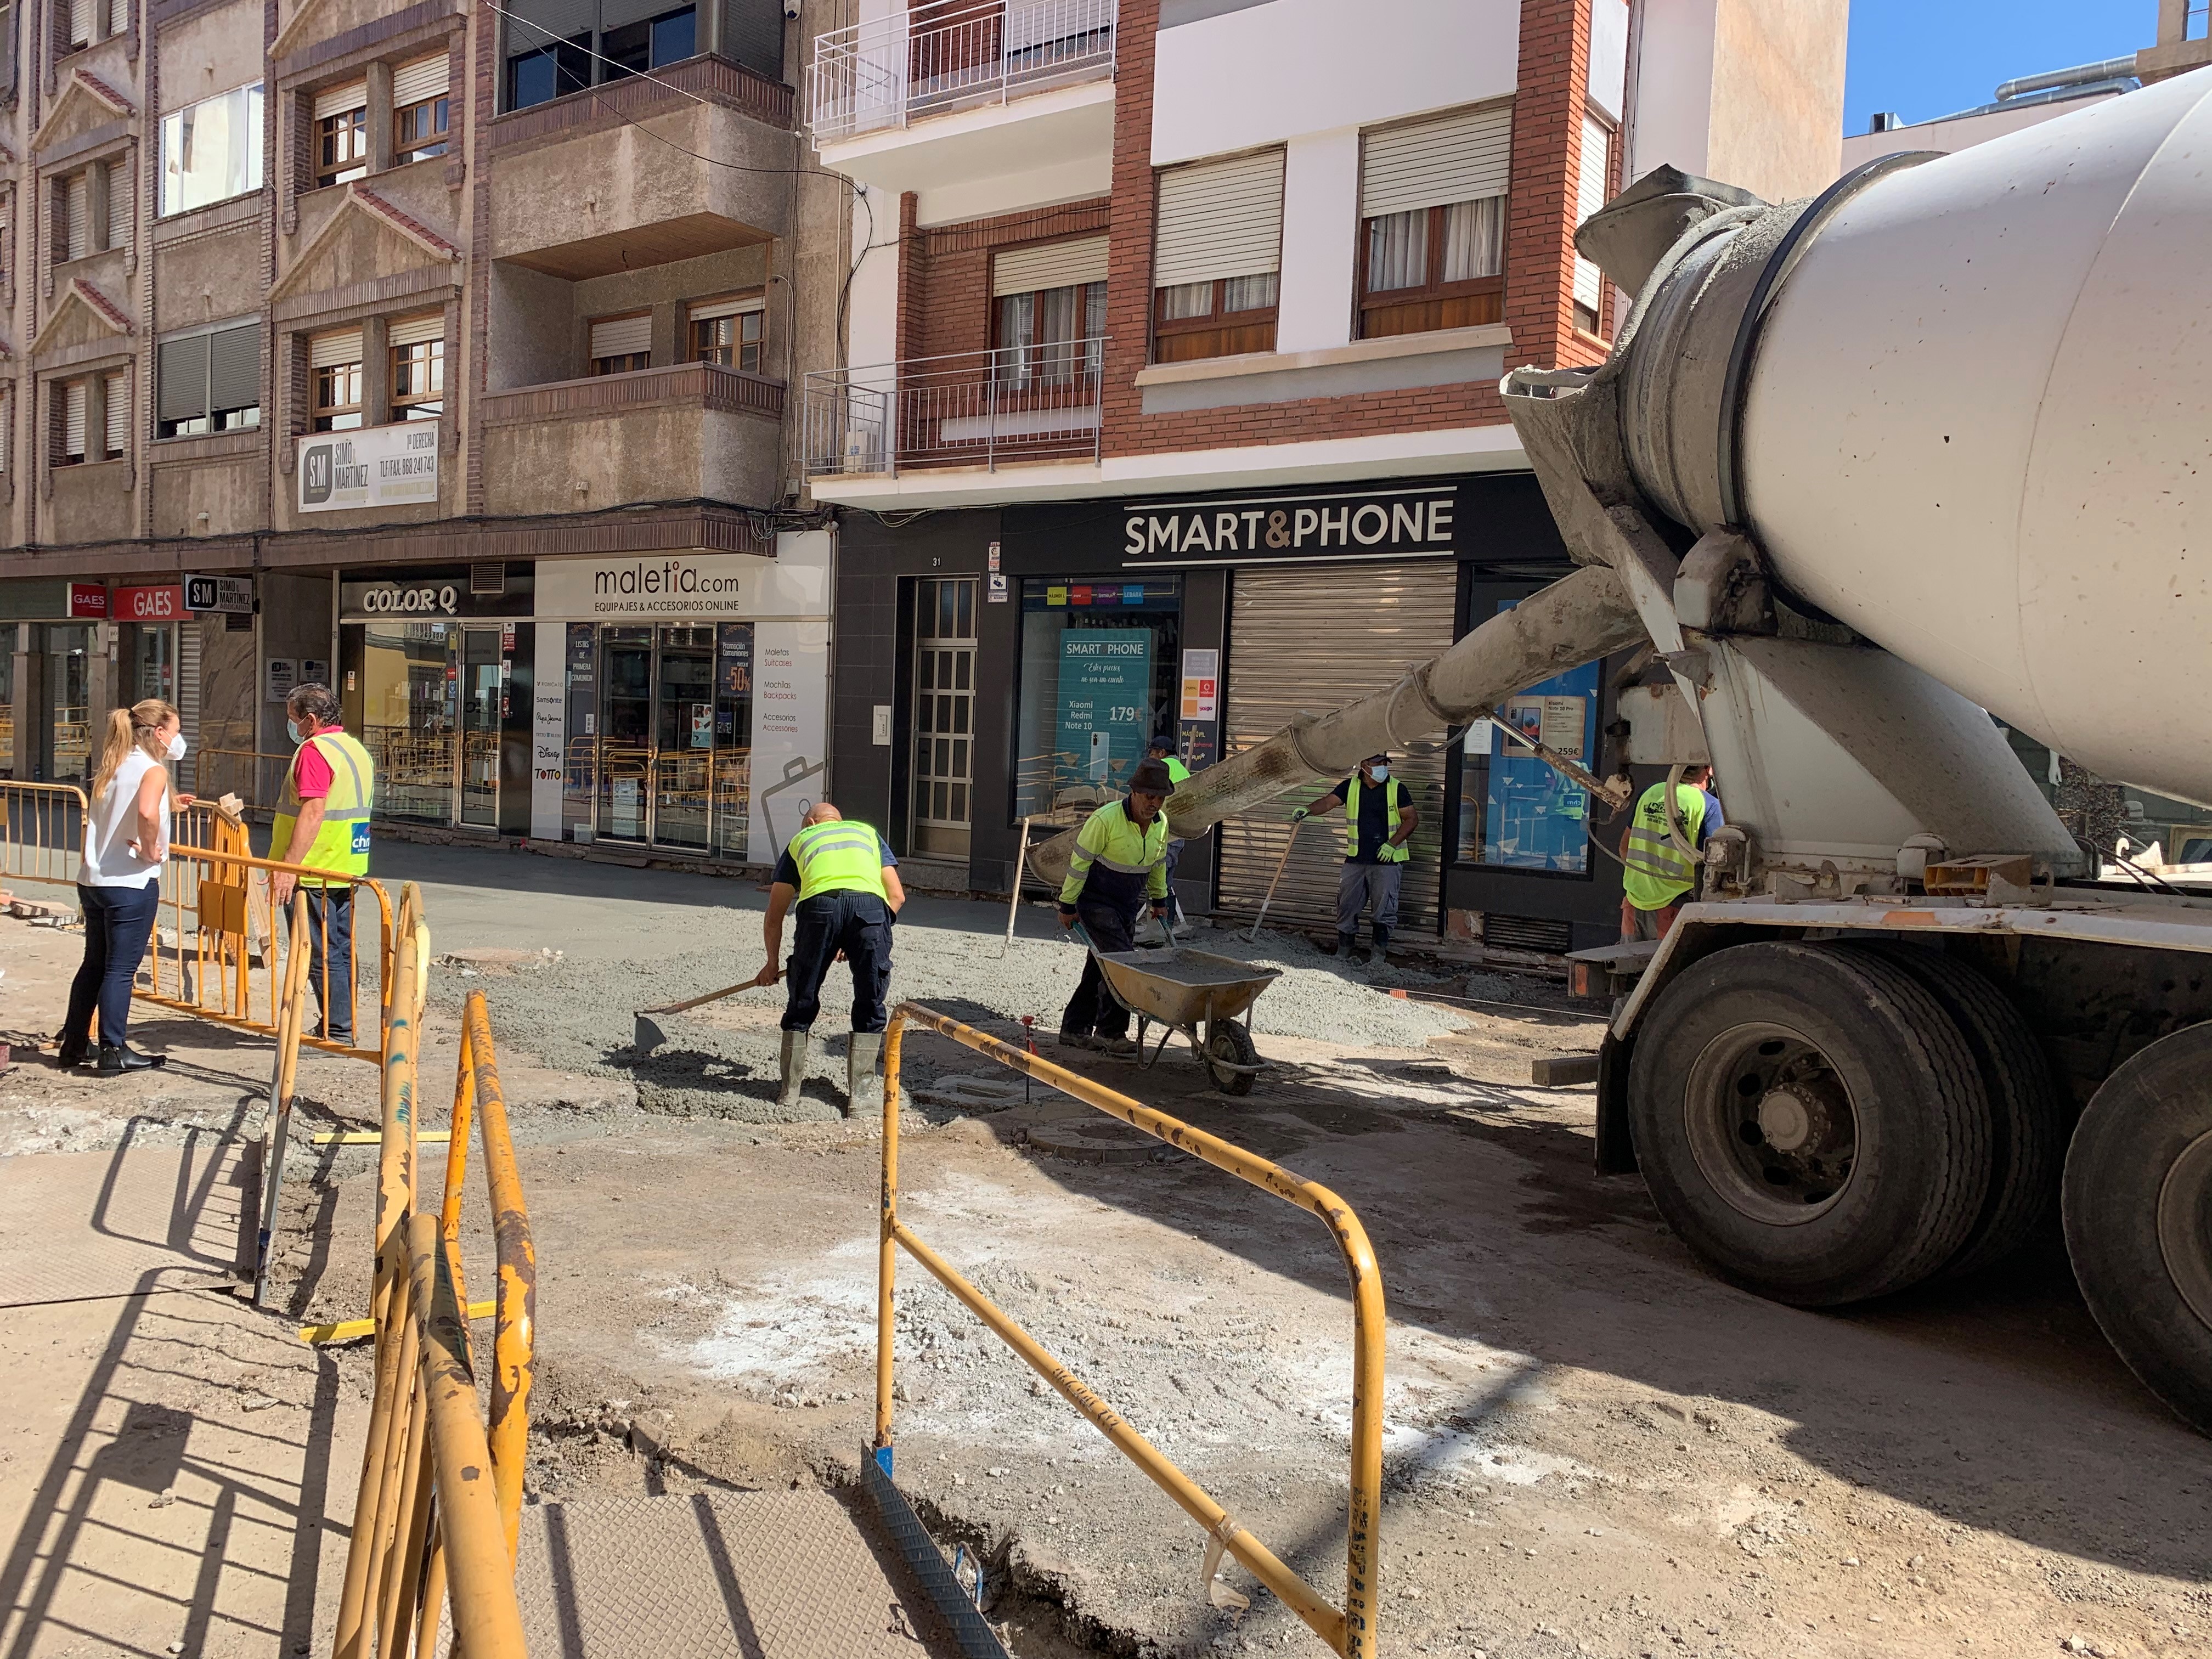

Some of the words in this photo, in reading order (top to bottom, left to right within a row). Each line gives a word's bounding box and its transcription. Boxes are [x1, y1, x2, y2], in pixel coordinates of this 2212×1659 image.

[413, 431, 435, 449] DERECHA
[402, 458, 413, 475] 868
[932, 557, 941, 567] 31
[595, 561, 738, 594] maletia.com
[74, 594, 105, 605] GAES
[134, 591, 171, 616] GAES
[363, 589, 437, 612] COLOR
[439, 585, 458, 615] Q
[595, 602, 637, 612] EQUIPAJES
[640, 602, 645, 611] &
[647, 601, 703, 611] ACCESORIOS
[705, 601, 738, 611] ONLINE
[1066, 644, 1101, 654] SMART
[1107, 644, 1144, 654] PHONE
[725, 667, 751, 691] -50%
[764, 681, 791, 689] Mochilas
[764, 692, 797, 700] Backpacks
[1069, 701, 1093, 709] Xiaomi
[763, 713, 796, 722] Accesorios
[1071, 711, 1092, 719] Redmi
[1110, 706, 1143, 721] 179€
[763, 724, 798, 732] Accessories
[1065, 721, 1082, 730] Note
[1084, 722, 1092, 730] 10
[1558, 747, 1579, 755] 259€
[535, 768, 561, 780] TOTTO
